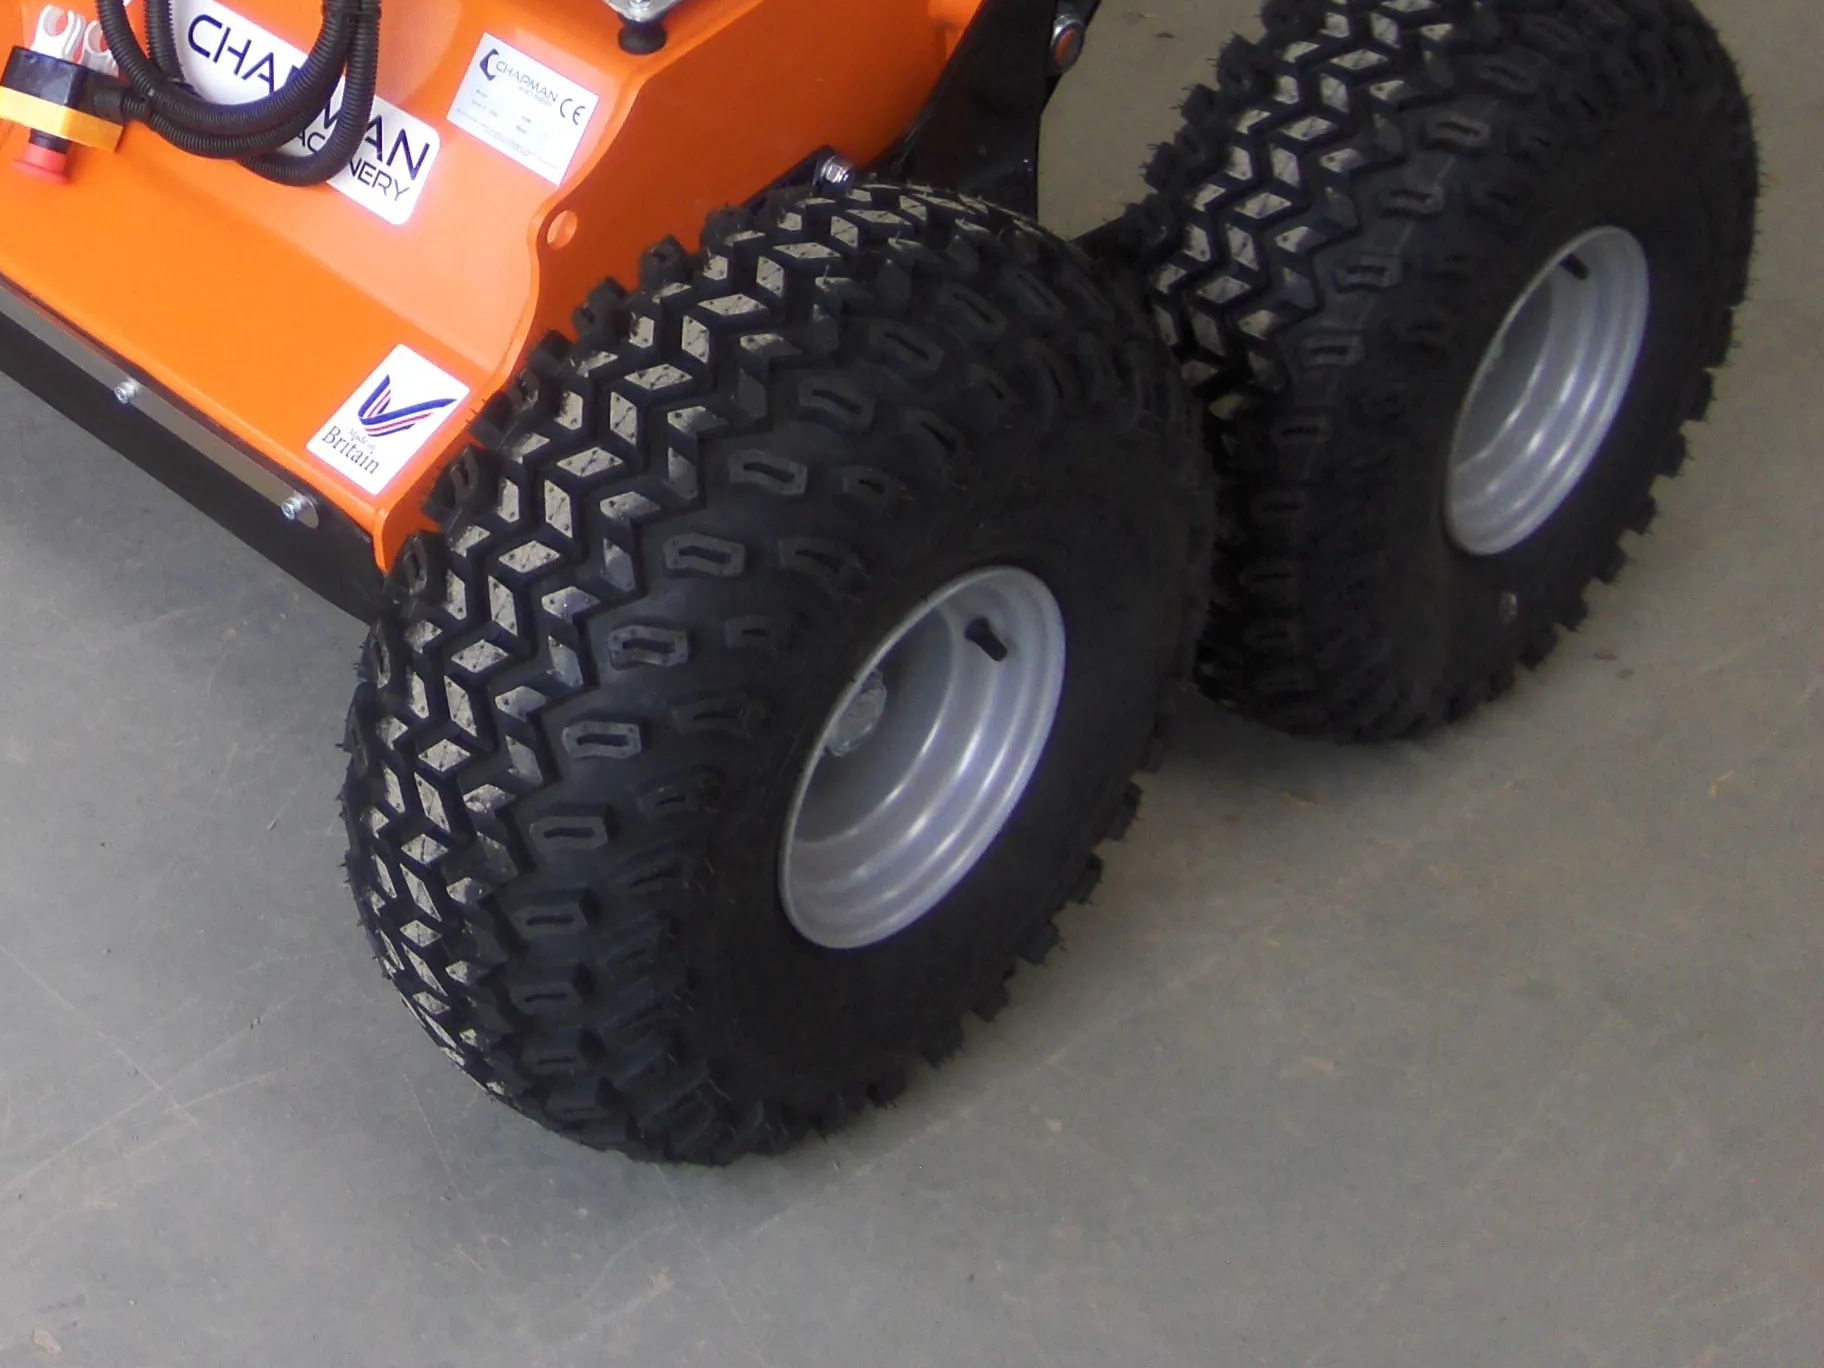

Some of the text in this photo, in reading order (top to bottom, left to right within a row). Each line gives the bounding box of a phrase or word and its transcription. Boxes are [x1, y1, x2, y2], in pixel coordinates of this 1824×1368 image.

[495, 60, 559, 103] CHAPMAN
[560, 98, 586, 126] CE
[321, 424, 380, 475] Britain
